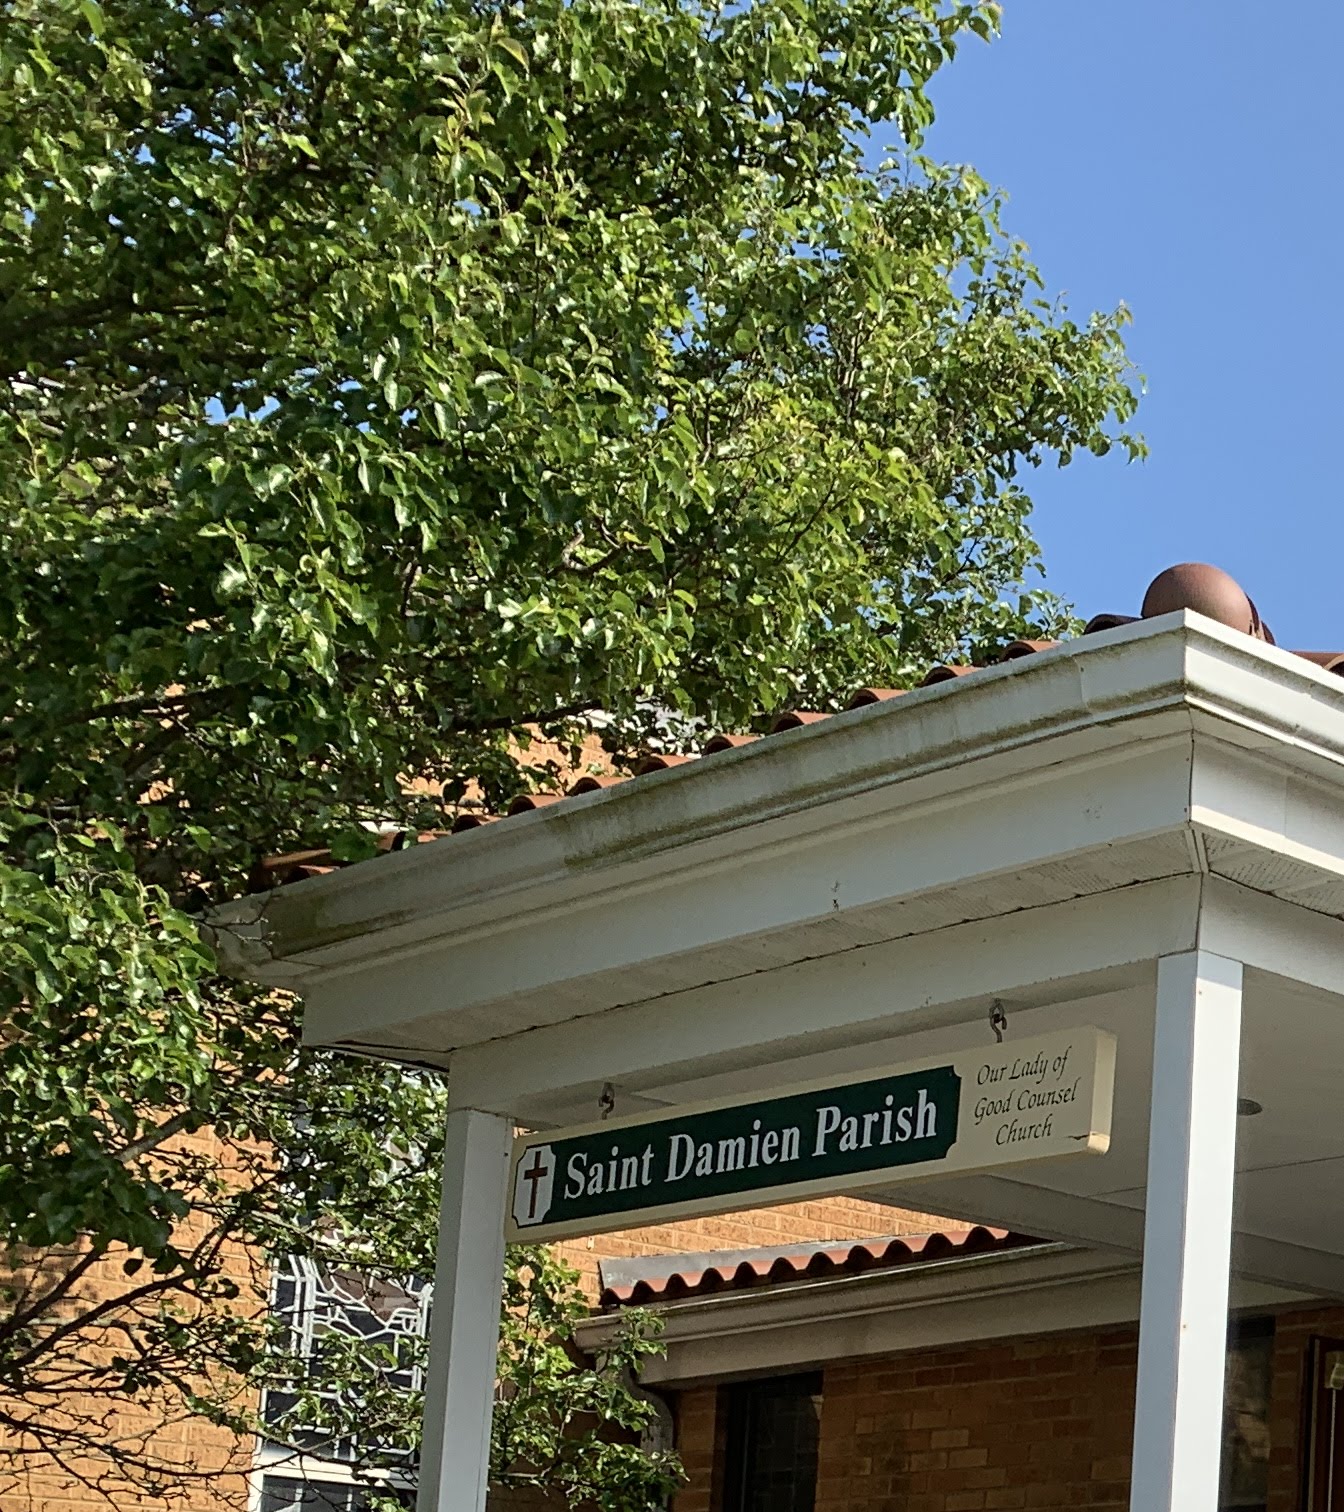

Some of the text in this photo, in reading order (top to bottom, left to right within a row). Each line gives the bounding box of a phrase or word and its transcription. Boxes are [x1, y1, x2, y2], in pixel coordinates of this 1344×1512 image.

[977, 1046, 1071, 1085] Our Lady of
[974, 1080, 1078, 1125] Good Counsel
[563, 1089, 938, 1200] Saint Damien Parish
[996, 1121, 1053, 1147] Church
